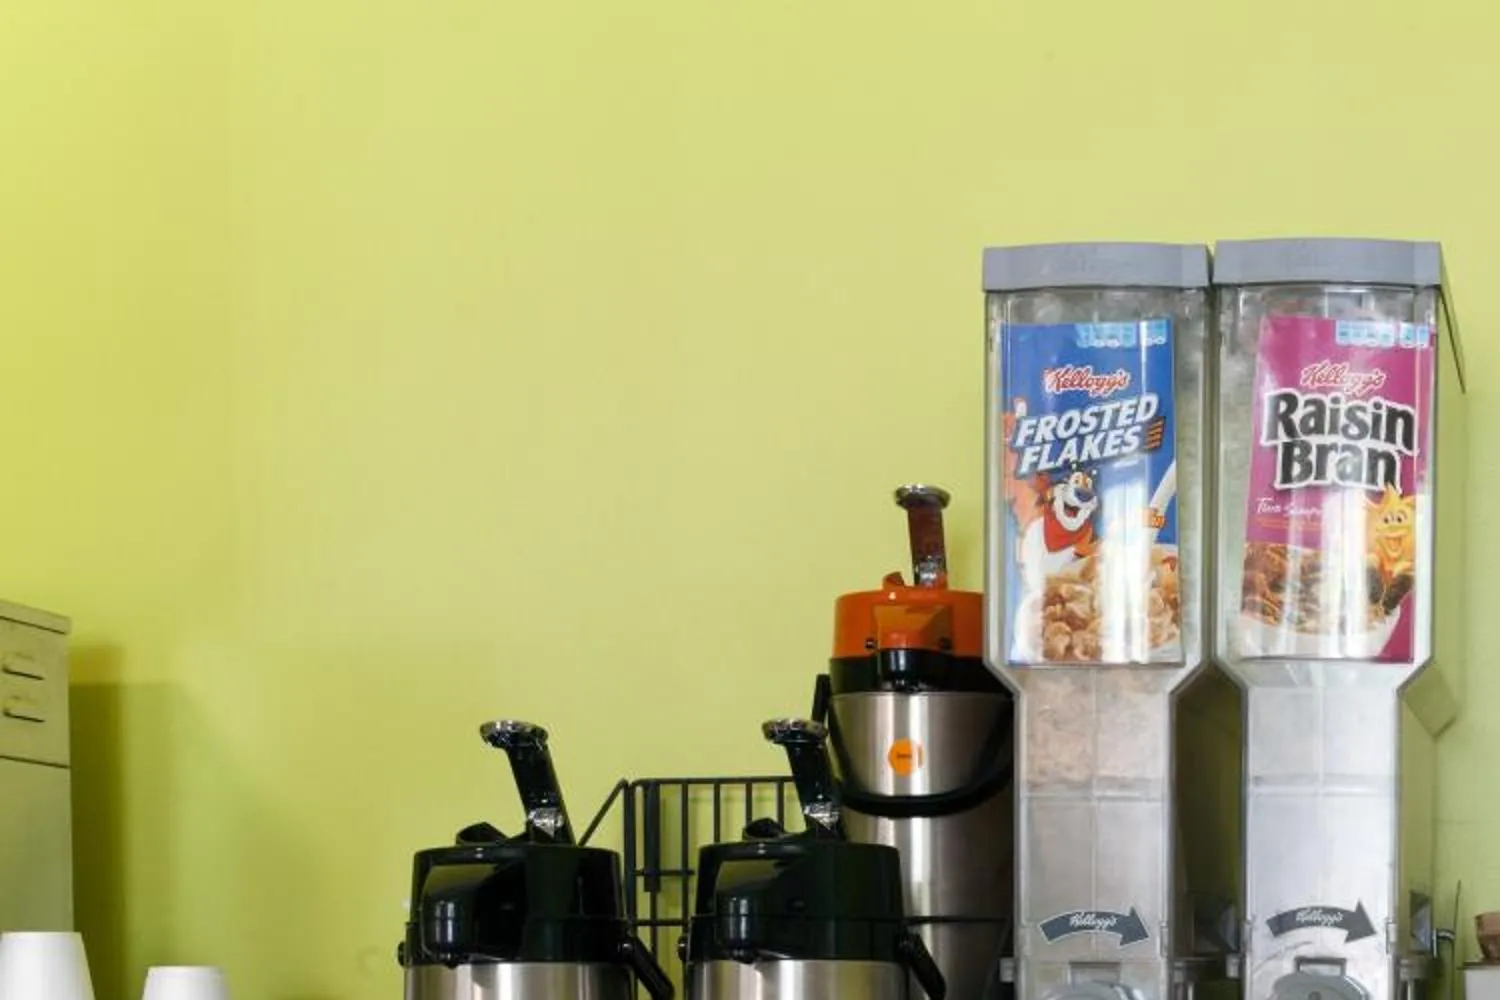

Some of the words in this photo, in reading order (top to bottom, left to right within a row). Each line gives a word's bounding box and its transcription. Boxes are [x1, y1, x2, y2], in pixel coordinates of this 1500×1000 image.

[1043, 365, 1130, 397] Kellogg's
[1303, 361, 1386, 397] Kellogg's
[1015, 394, 1159, 448] FROSTED
[1261, 389, 1420, 455] Raisin
[1020, 426, 1142, 476] FLAKES
[1275, 440, 1401, 492] Bran
[1068, 911, 1118, 930] Kellogg's
[1293, 907, 1344, 927] Kellogg's
